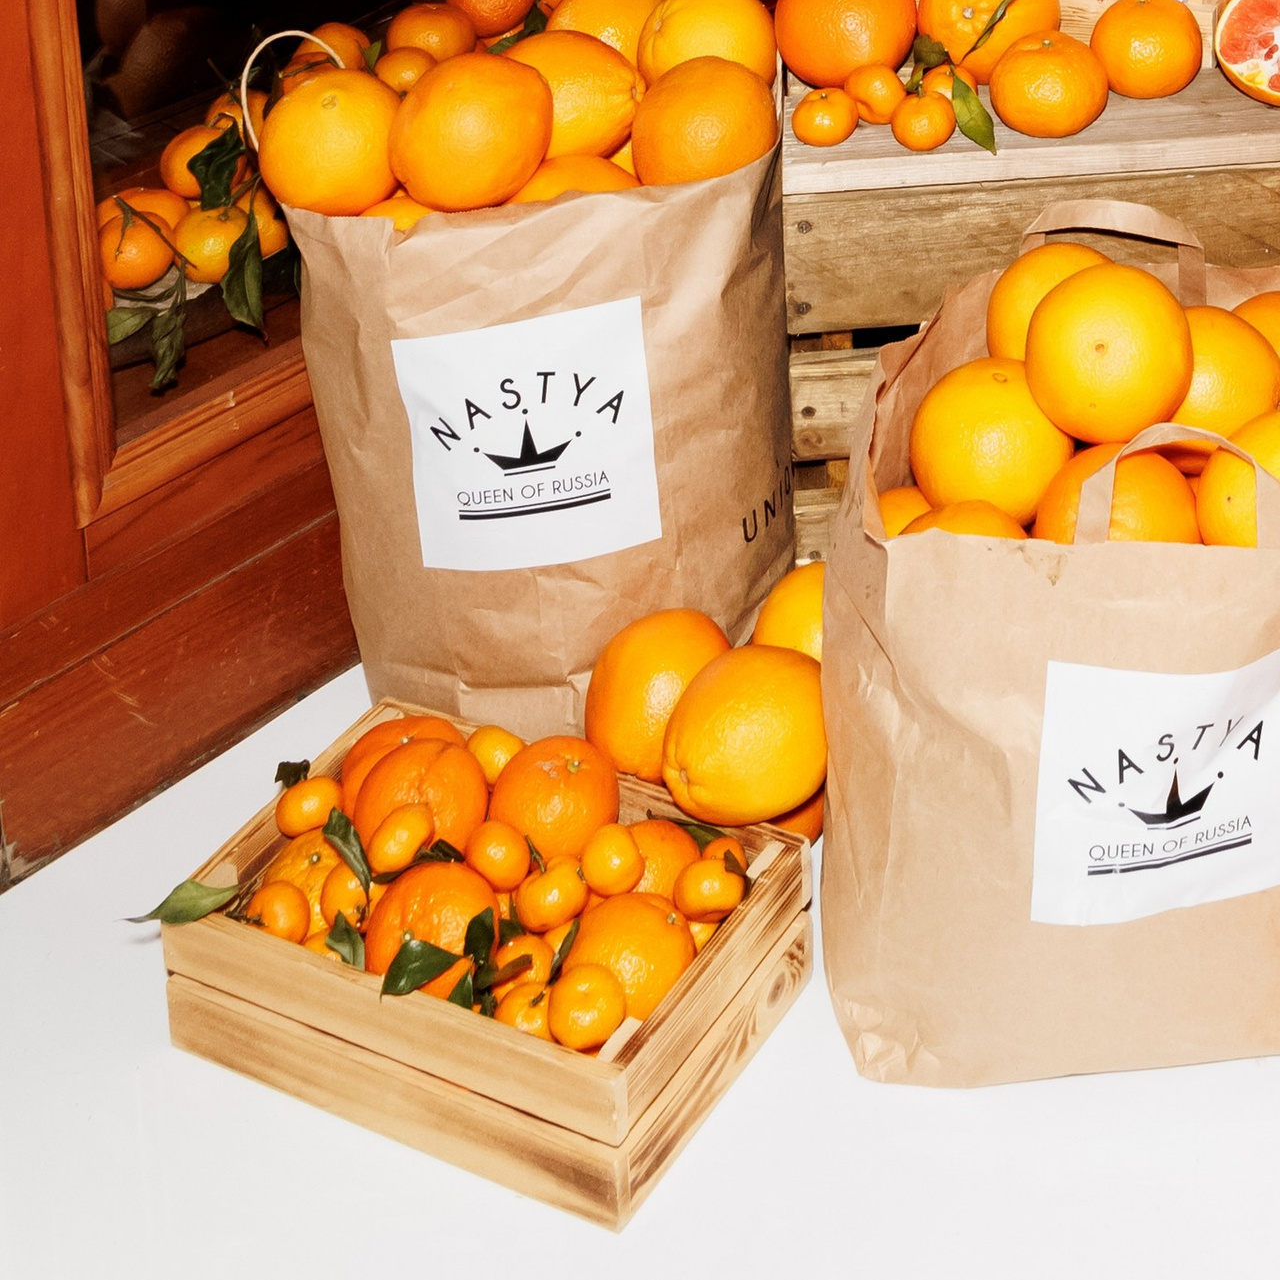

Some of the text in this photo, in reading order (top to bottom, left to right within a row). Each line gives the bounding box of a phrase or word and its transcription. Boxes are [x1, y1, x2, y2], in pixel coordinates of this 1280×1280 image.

[429, 371, 625, 452] NASTYA
[456, 470, 610, 507] QUEEN OF RUSSIA
[1067, 715, 1264, 804] NASTYA
[1088, 815, 1252, 862] QUEEN OF RUSSIA
